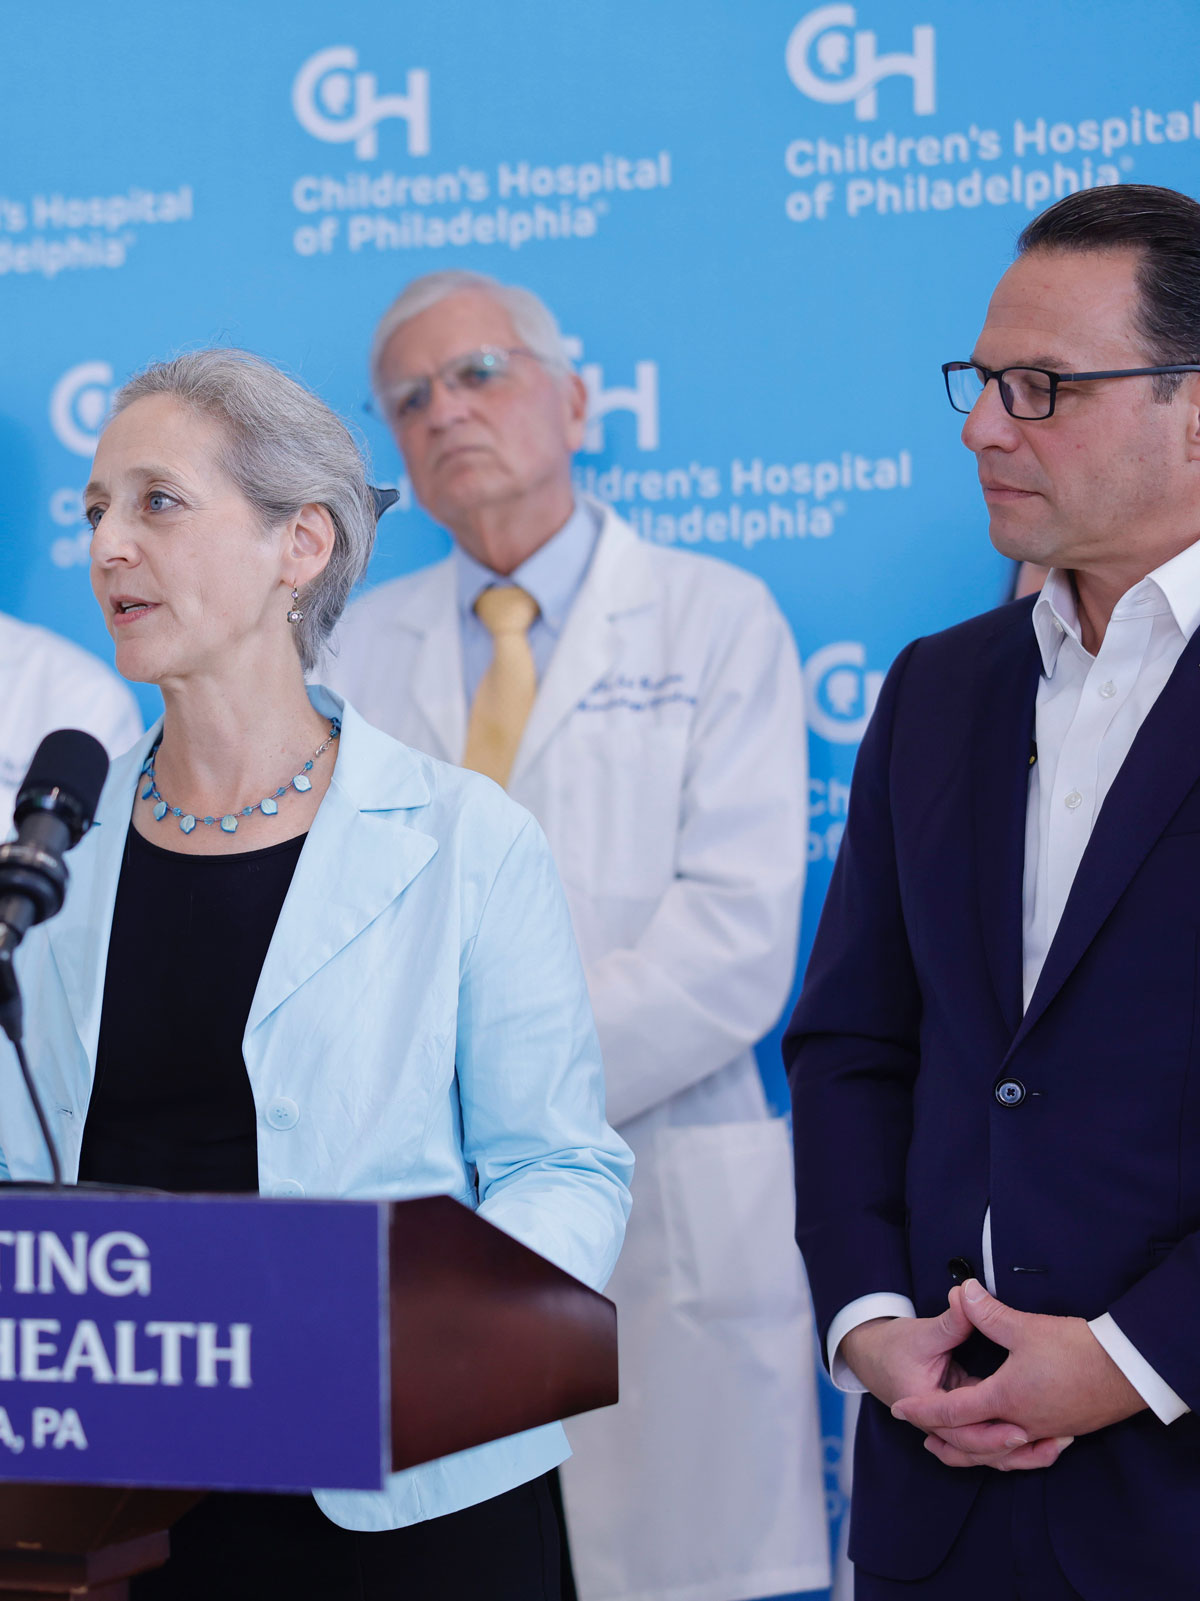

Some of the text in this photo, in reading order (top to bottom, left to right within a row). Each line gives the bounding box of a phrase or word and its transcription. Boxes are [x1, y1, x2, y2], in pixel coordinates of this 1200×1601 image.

[785, 101, 1200, 177] Children's Hospital
[293, 150, 672, 212] Children's Hospital
[785, 180, 834, 222] of
[32, 184, 193, 231] Hospital
[294, 217, 338, 256] of
[731, 450, 913, 500] Hospital
[31, 1407, 89, 1450] PA
